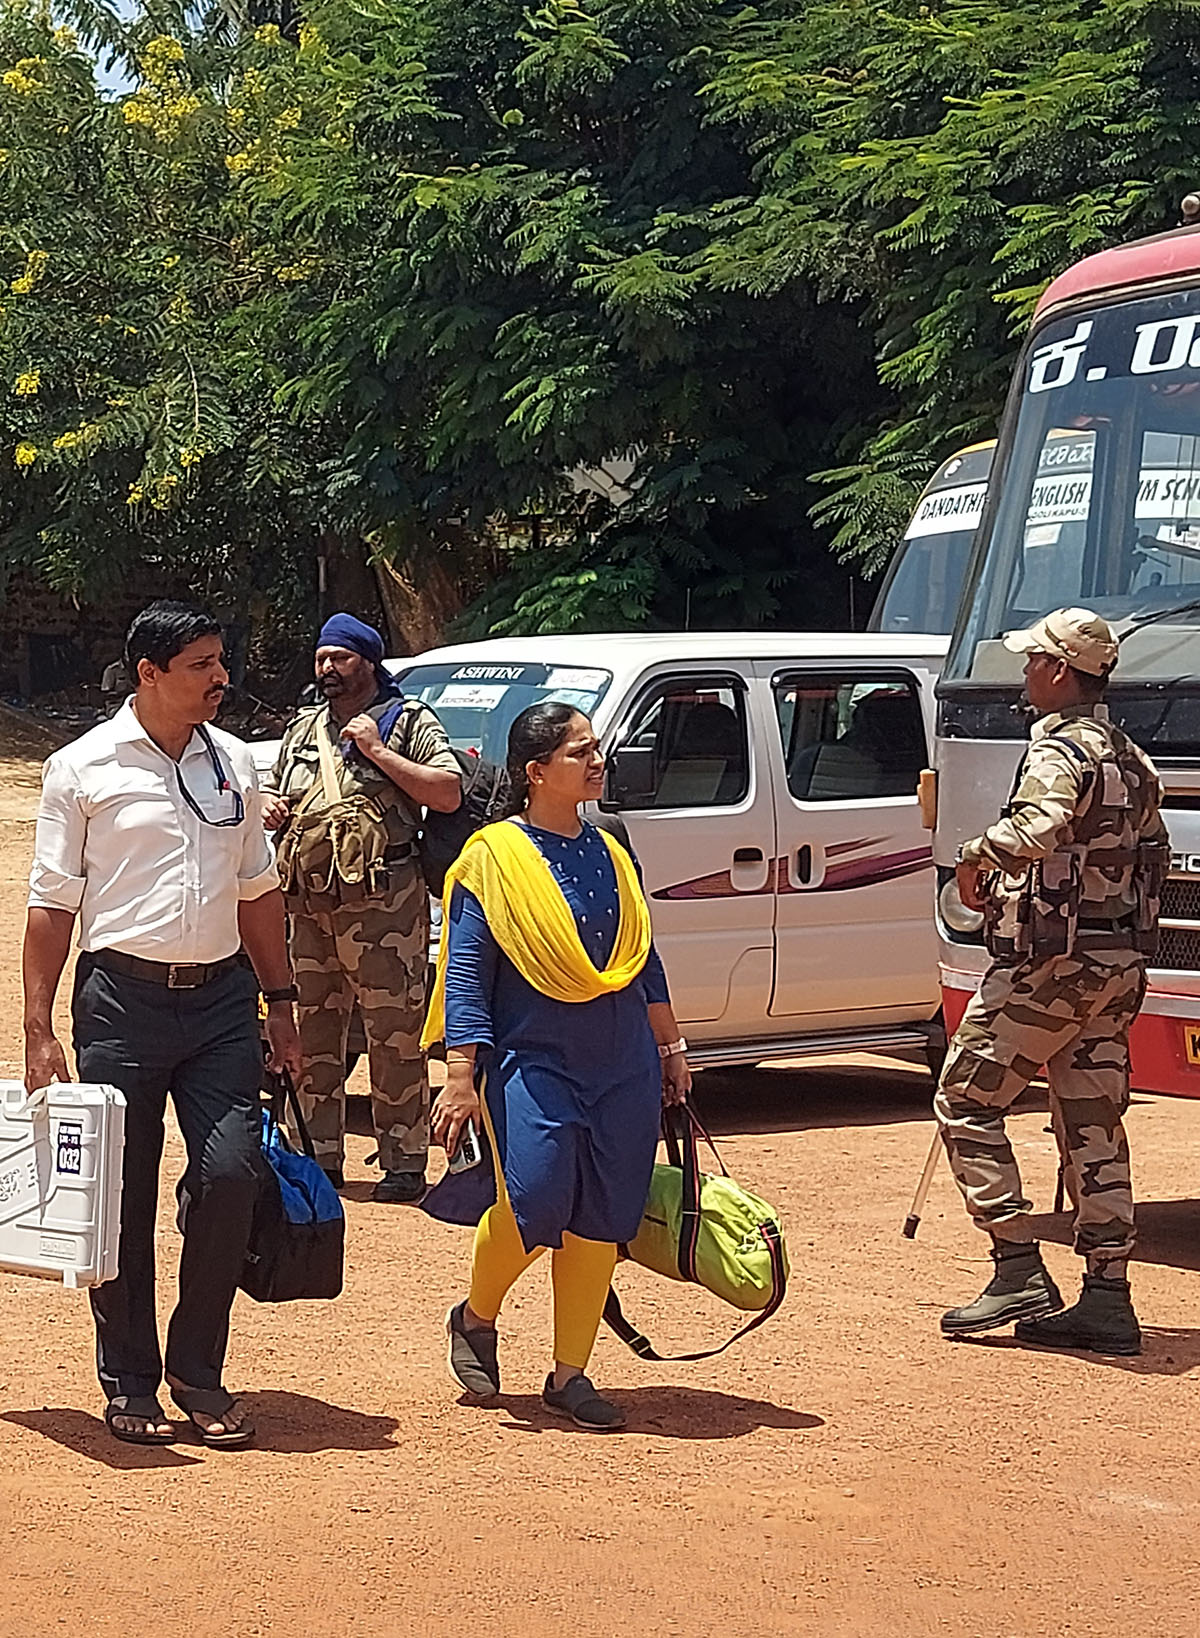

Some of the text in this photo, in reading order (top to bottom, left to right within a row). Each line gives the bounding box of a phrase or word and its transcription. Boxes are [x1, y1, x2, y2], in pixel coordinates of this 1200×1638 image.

[920, 492, 986, 521] DANDATHI
[1032, 481, 1088, 508] ENGLISH
[451, 666, 525, 679] ASHWINI
[59, 1147, 81, 1170] 032
